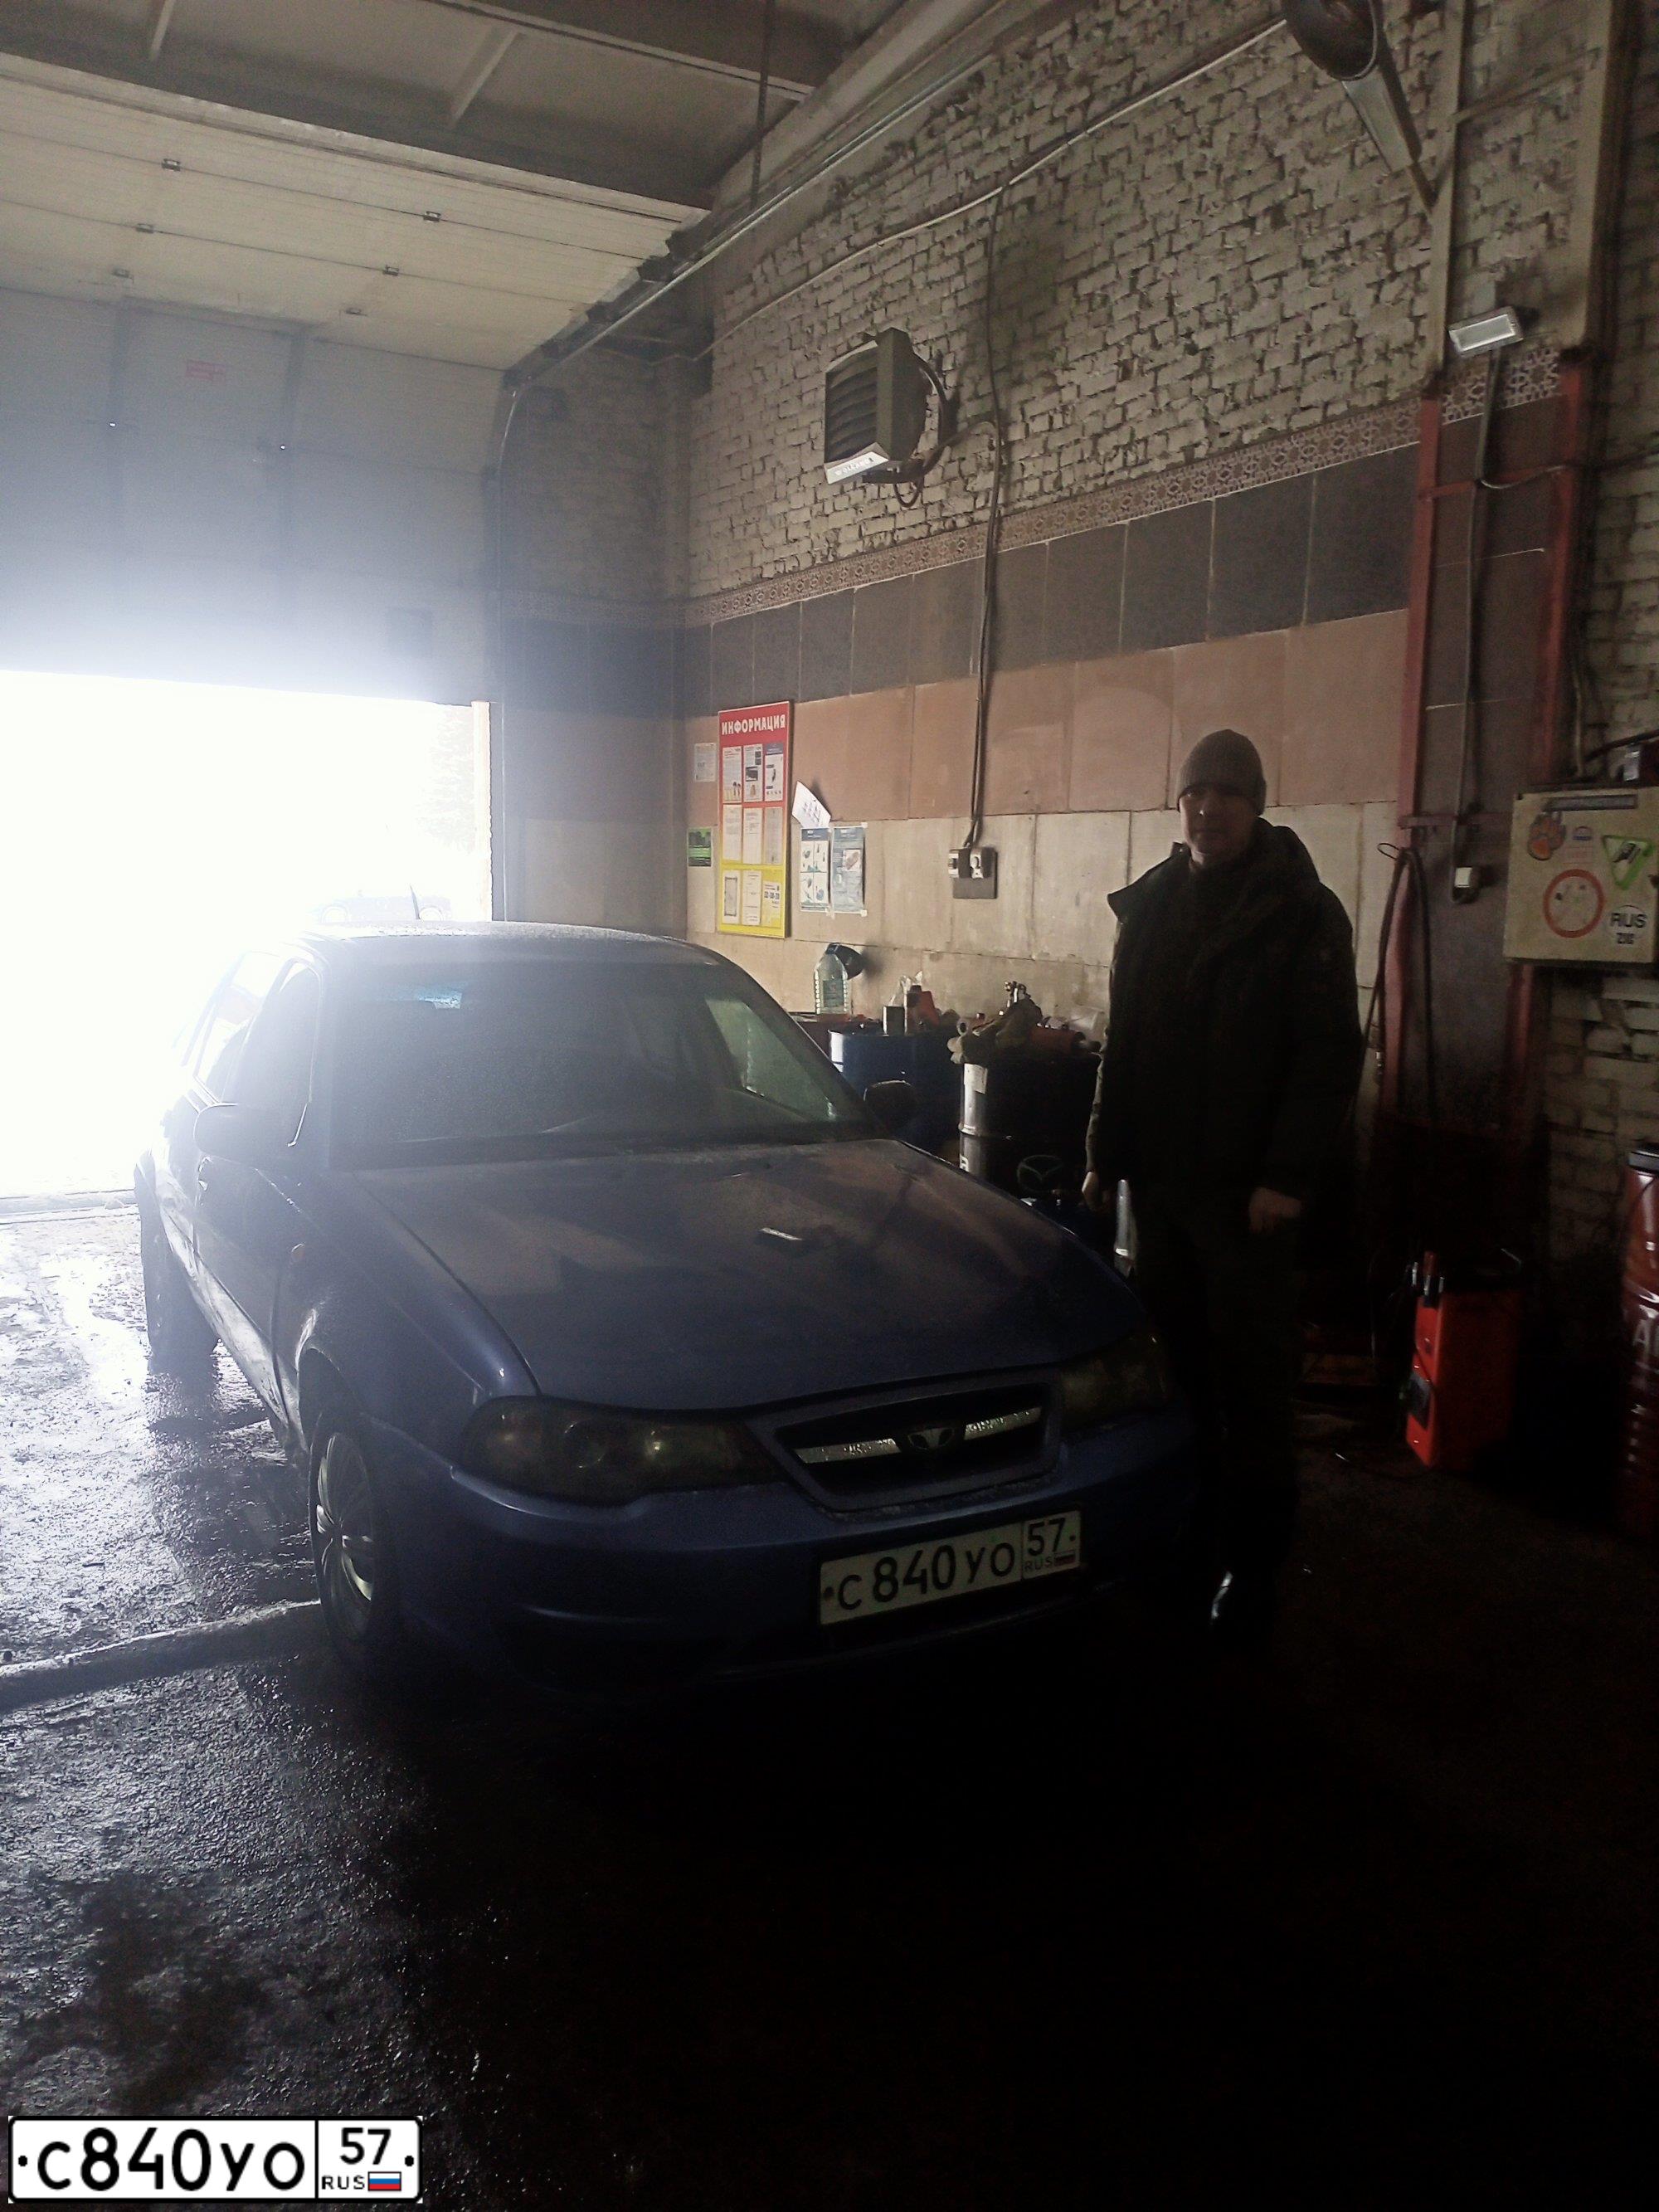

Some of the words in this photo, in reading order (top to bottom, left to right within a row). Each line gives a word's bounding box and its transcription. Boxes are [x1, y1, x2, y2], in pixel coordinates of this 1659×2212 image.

[721, 714, 786, 735] ИНФОРМАЦИЯ
[1610, 913, 1647, 928] RUS
[1027, 1517, 1066, 1557] 57
[1024, 1556, 1053, 1573] RUS
